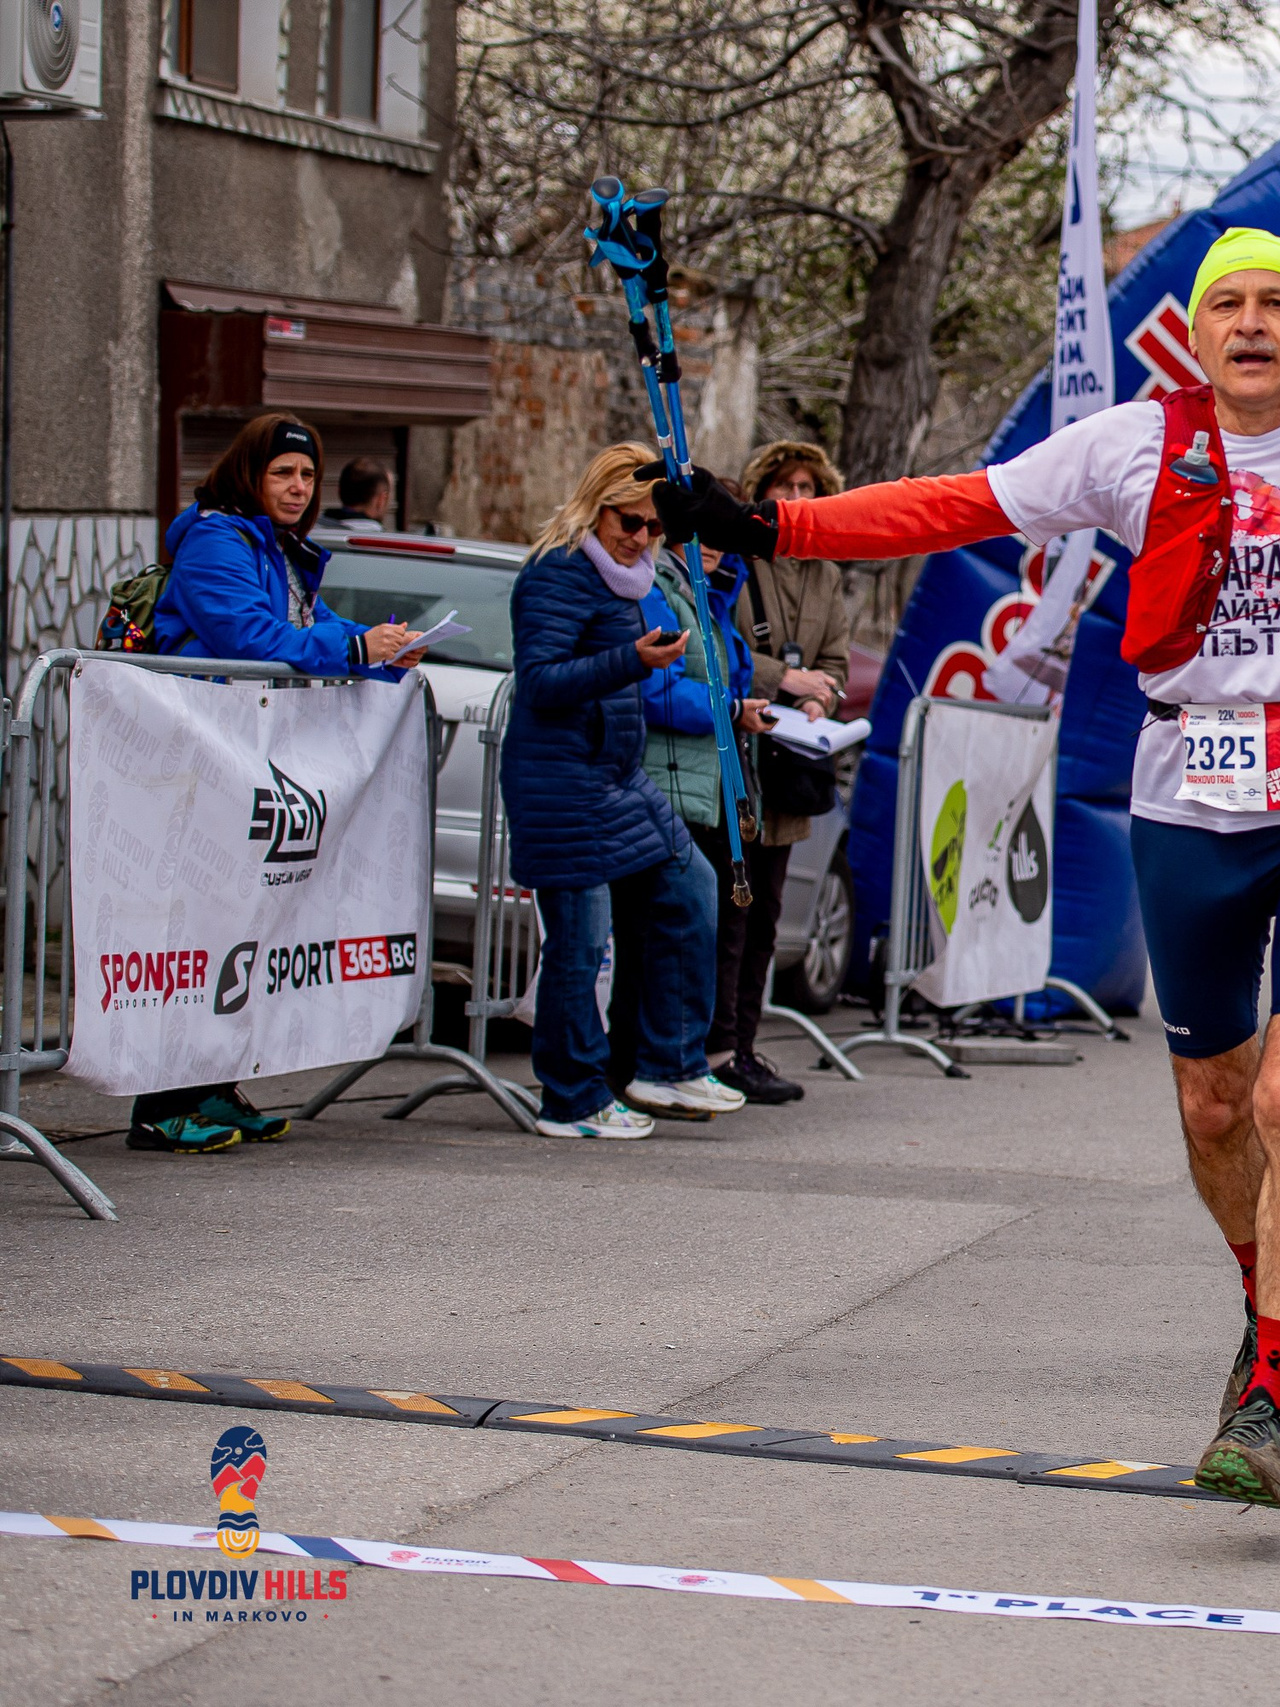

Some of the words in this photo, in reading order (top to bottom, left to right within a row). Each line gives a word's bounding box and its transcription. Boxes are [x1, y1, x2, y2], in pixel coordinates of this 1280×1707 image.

[1217, 709, 1235, 721] 22K
[1184, 735, 1256, 771] 2325
[1216, 774, 1235, 784] TRAIL
[266, 939, 336, 995] SPORT
[100, 949, 208, 1014] SPONSER
[119, 997, 158, 1010] SPORT
[174, 994, 205, 1006] FOOD
[994, 1597, 1245, 1625] PLACE
